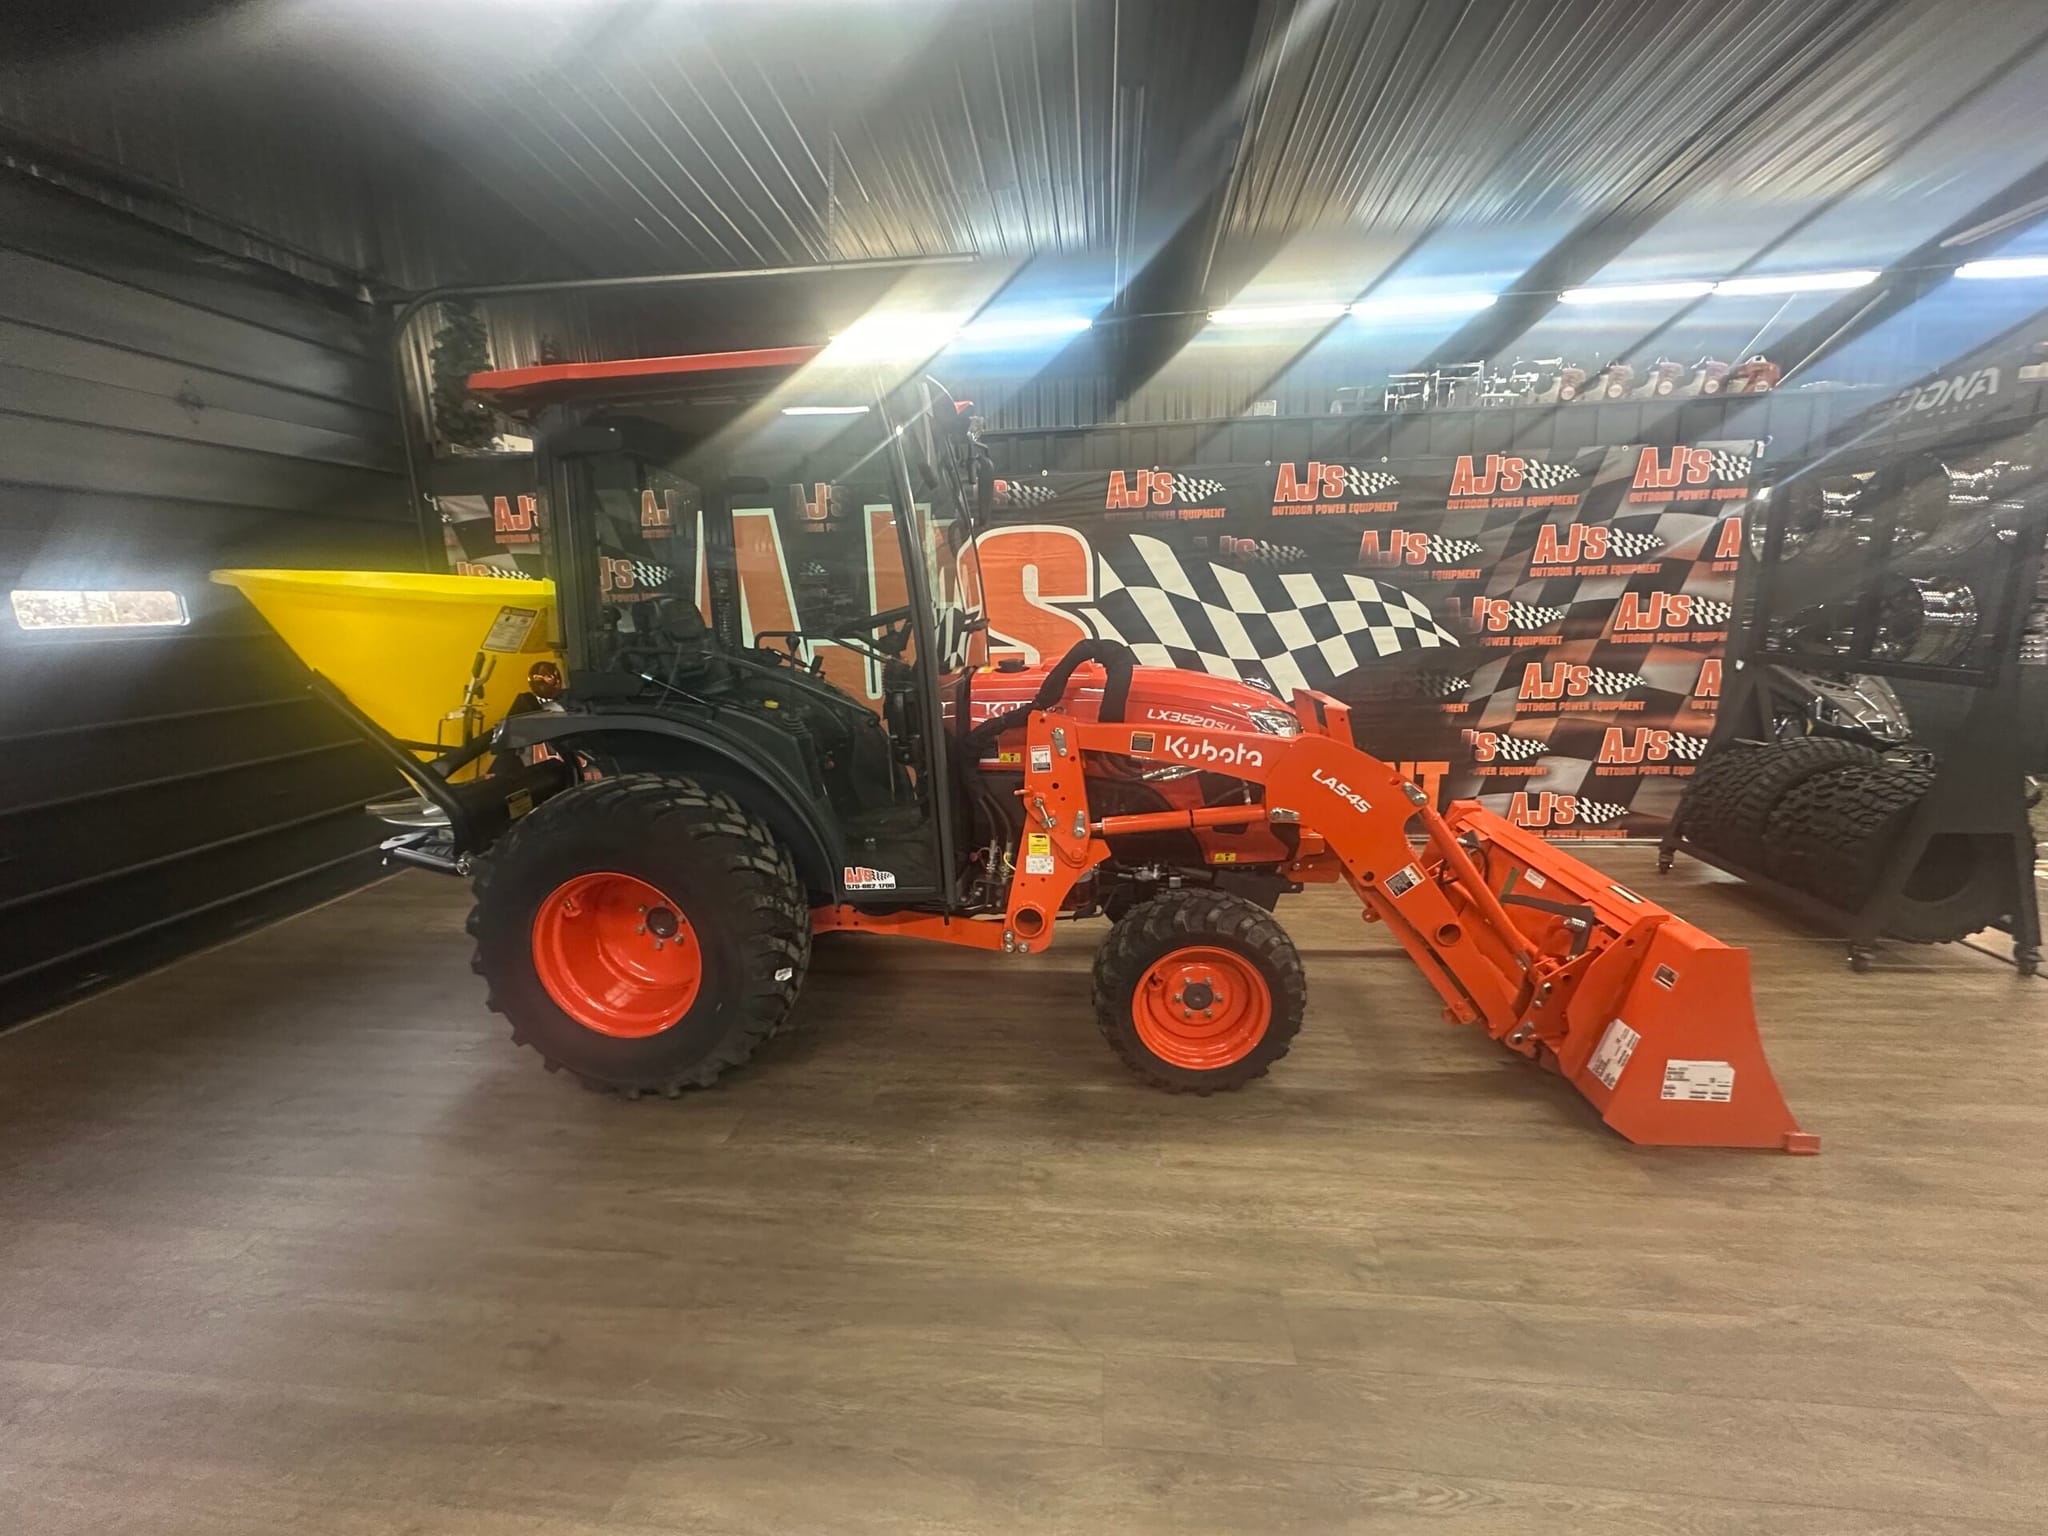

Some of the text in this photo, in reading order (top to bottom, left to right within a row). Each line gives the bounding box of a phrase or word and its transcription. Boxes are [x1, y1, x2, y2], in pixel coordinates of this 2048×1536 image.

[1274, 462, 1345, 502] AJ'S
[1449, 454, 1524, 496] AJ'S
[1632, 446, 1712, 488] AJ'S
[1105, 469, 1173, 509] AJ'S
[1446, 493, 1580, 510] OUTDOOR POWER EQUIPMENT
[1178, 507, 1226, 521] EQUIPMENT
[1271, 501, 1399, 516] OUTDOOR POWER EQUIPMENT
[1359, 529, 1428, 568] AJ'S
[1532, 523, 1608, 564] AJ'S
[1530, 563, 1662, 578] OUTDOOR POWER EQUIPMENT
[1614, 591, 1691, 631] AJ'S
[1512, 635, 1564, 648] EQUIPMENT
[1518, 662, 1591, 699] AJ'S
[1515, 700, 1647, 712] OUTDOOR POWER EQUIPMENT
[1164, 735, 1263, 767] Kubota
[1598, 727, 1670, 763] AJ'S
[1499, 766, 1548, 776] EQUIPMENT
[1311, 768, 1373, 814] LA545
[1506, 791, 1577, 827] AJ'S
